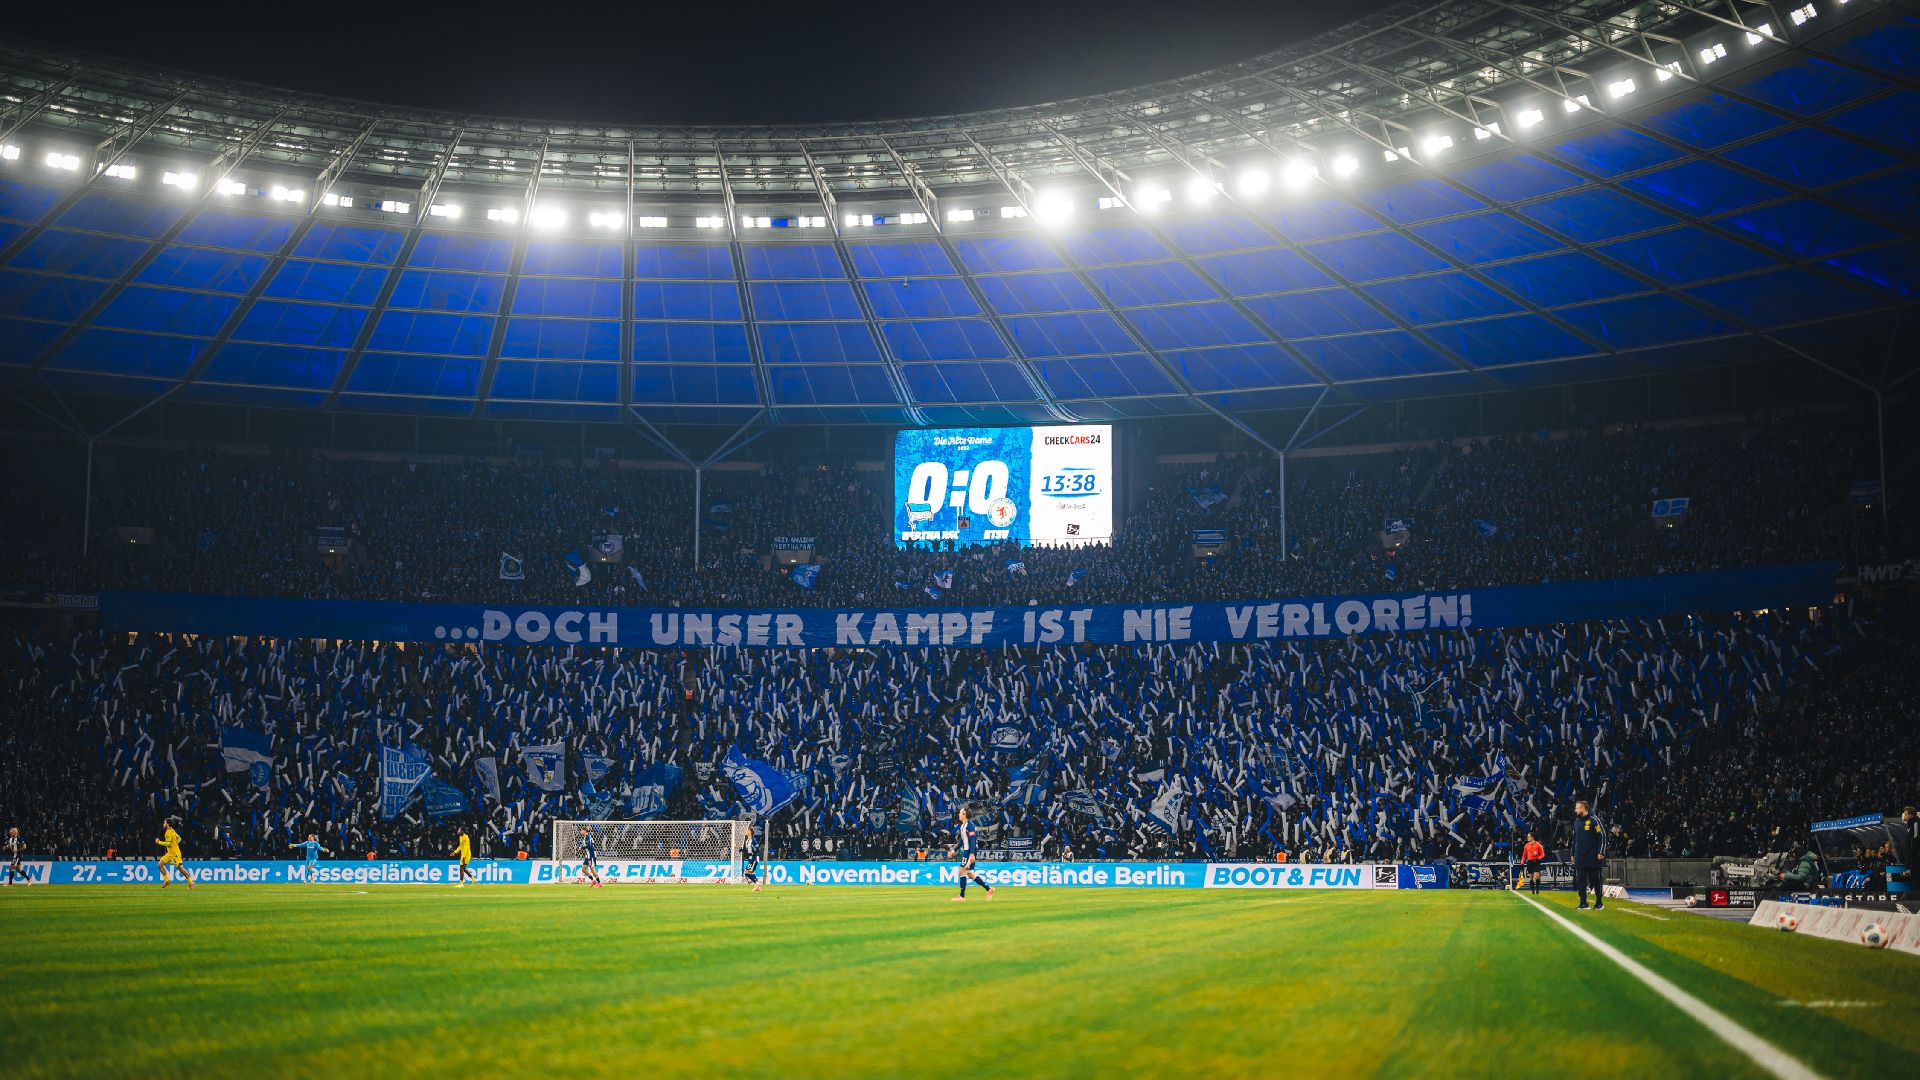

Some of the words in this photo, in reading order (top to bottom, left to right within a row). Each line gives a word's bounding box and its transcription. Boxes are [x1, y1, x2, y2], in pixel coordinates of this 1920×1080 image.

[1041, 474, 1096, 493] 13:38
[649, 612, 805, 647] UNSER
[835, 610, 995, 645] KAMPF
[1023, 608, 1093, 643] IST
[1123, 605, 1193, 642] NIE
[1225, 594, 1472, 639] VERLOREN!
[72, 864, 102, 882] 27.
[122, 864, 154, 882] 30.
[448, 862, 513, 882] Berlin
[800, 864, 919, 883] November
[1115, 865, 1185, 885] Berlin
[1213, 867, 1286, 886] BOOT
[1287, 867, 1305, 886] &
[1309, 868, 1362, 886] FUN
